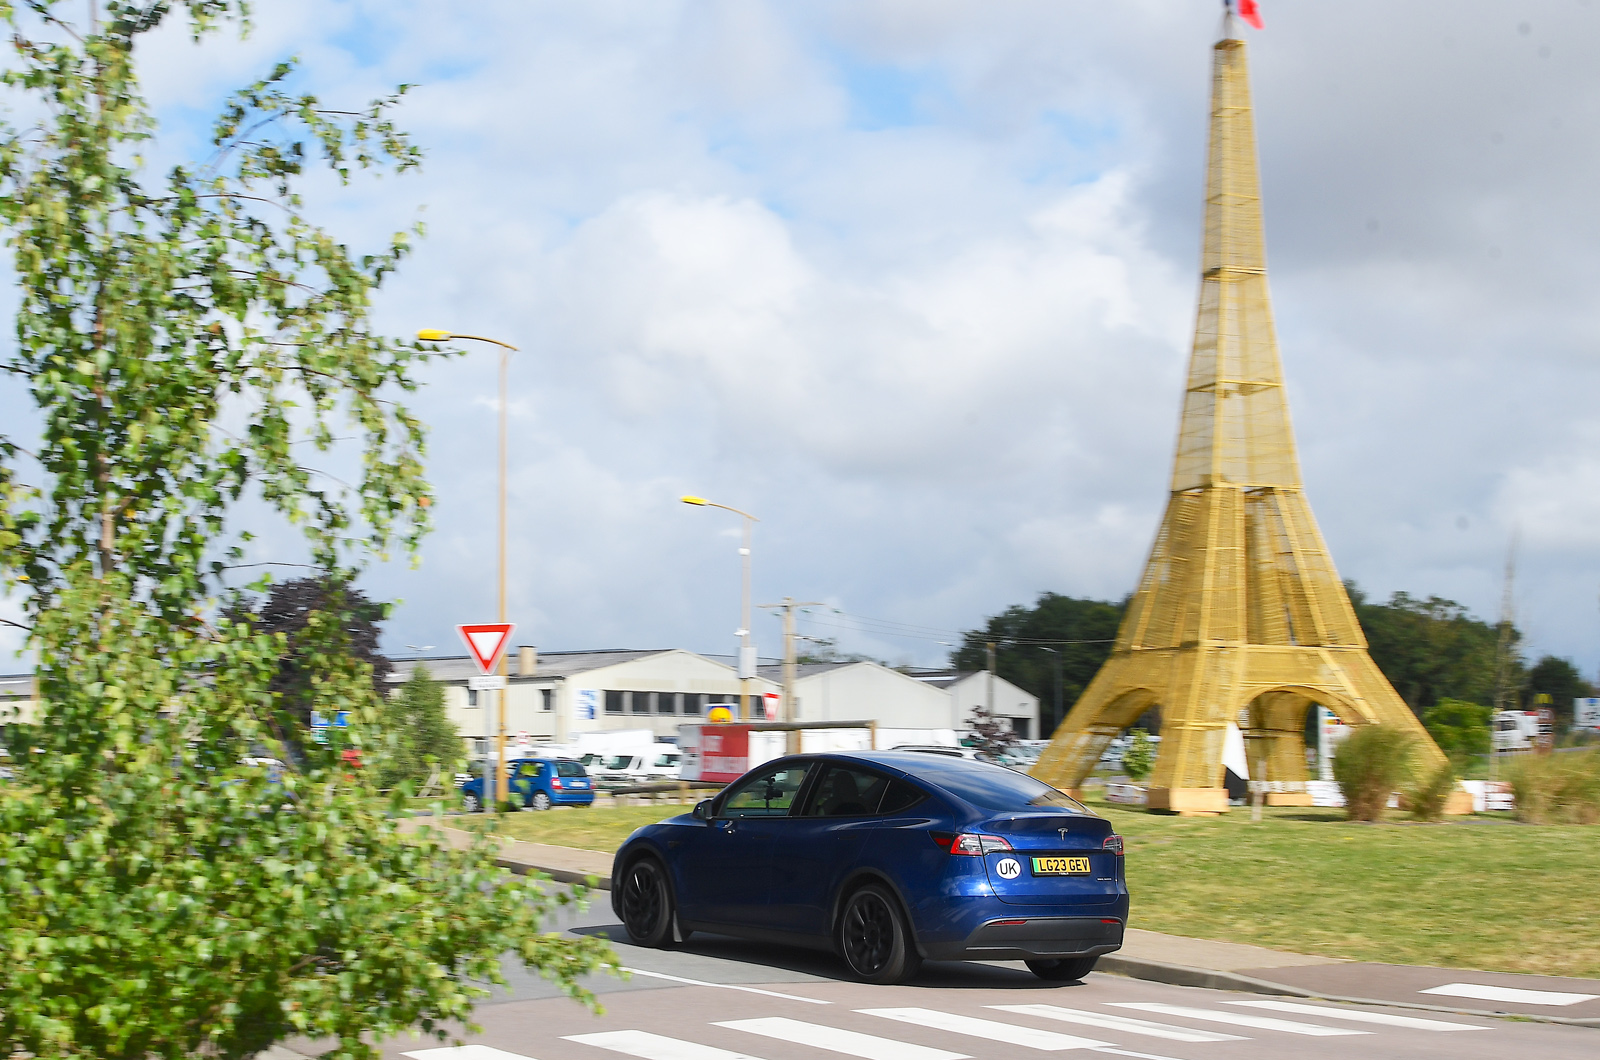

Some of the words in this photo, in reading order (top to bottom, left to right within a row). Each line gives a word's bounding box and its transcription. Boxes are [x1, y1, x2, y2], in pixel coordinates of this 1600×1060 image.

[1000, 862, 1018, 875] UK
[1039, 859, 1067, 872] LG23
[1068, 859, 1088, 872] GEV
